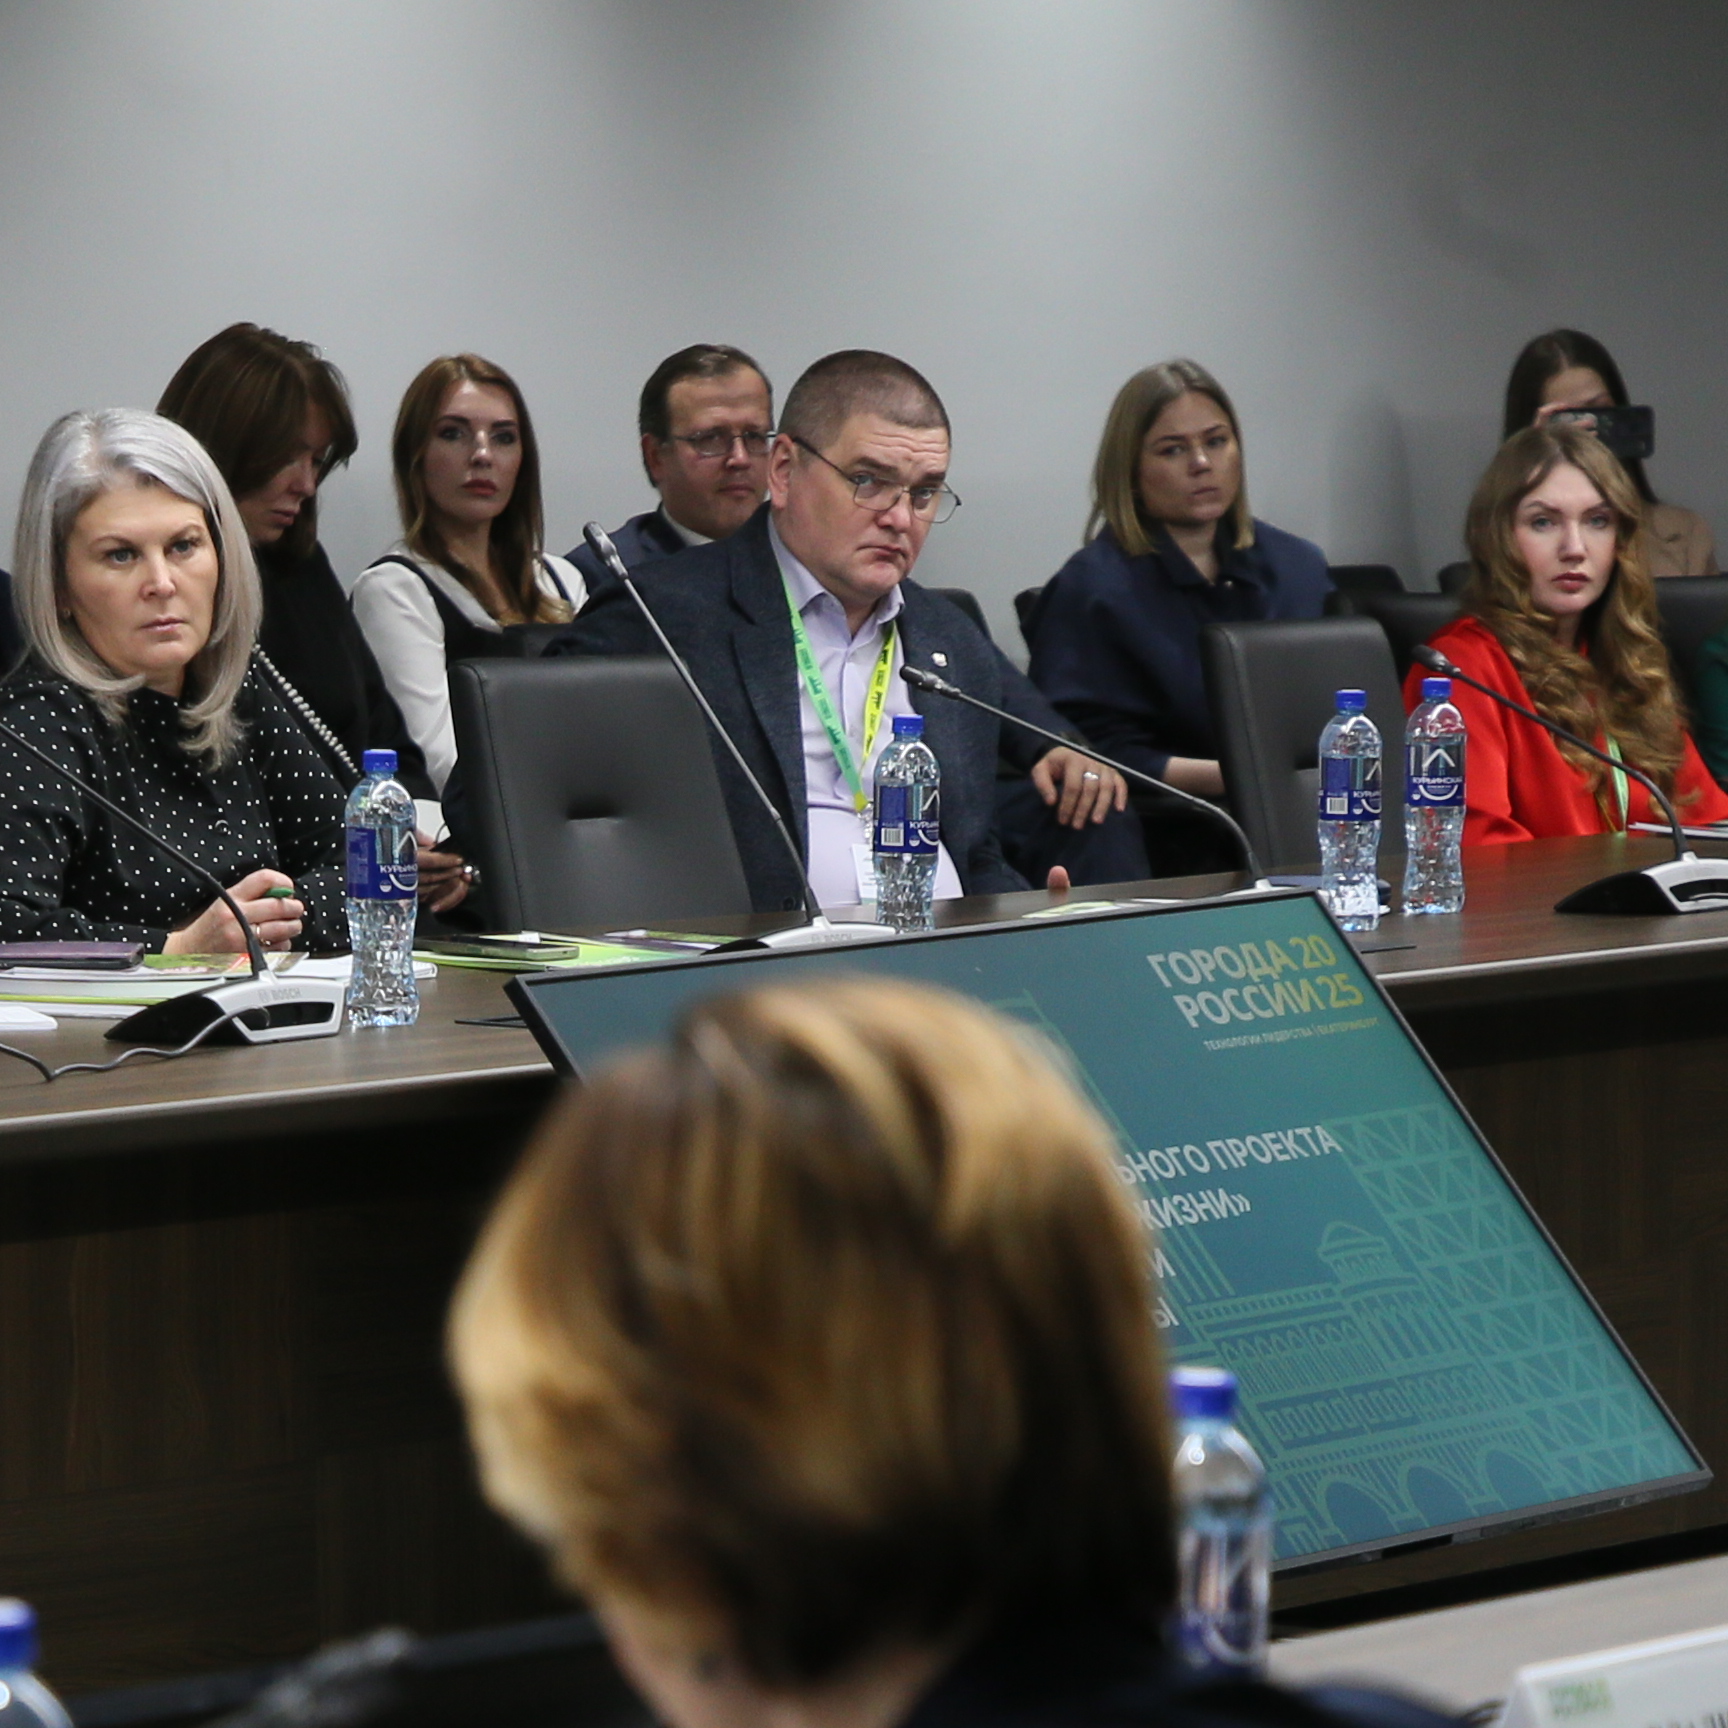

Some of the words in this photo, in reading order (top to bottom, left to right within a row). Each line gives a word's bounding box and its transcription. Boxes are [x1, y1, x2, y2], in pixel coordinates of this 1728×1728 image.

[1146, 939, 1299, 988] ГОРОДА
[1288, 934, 1337, 970] 20
[1172, 977, 1326, 1029] РОССИИ
[1315, 972, 1365, 1009] 25
[1110, 1144, 1211, 1186] ЬНОГО
[1205, 1124, 1344, 1170] ПРОЕКТА
